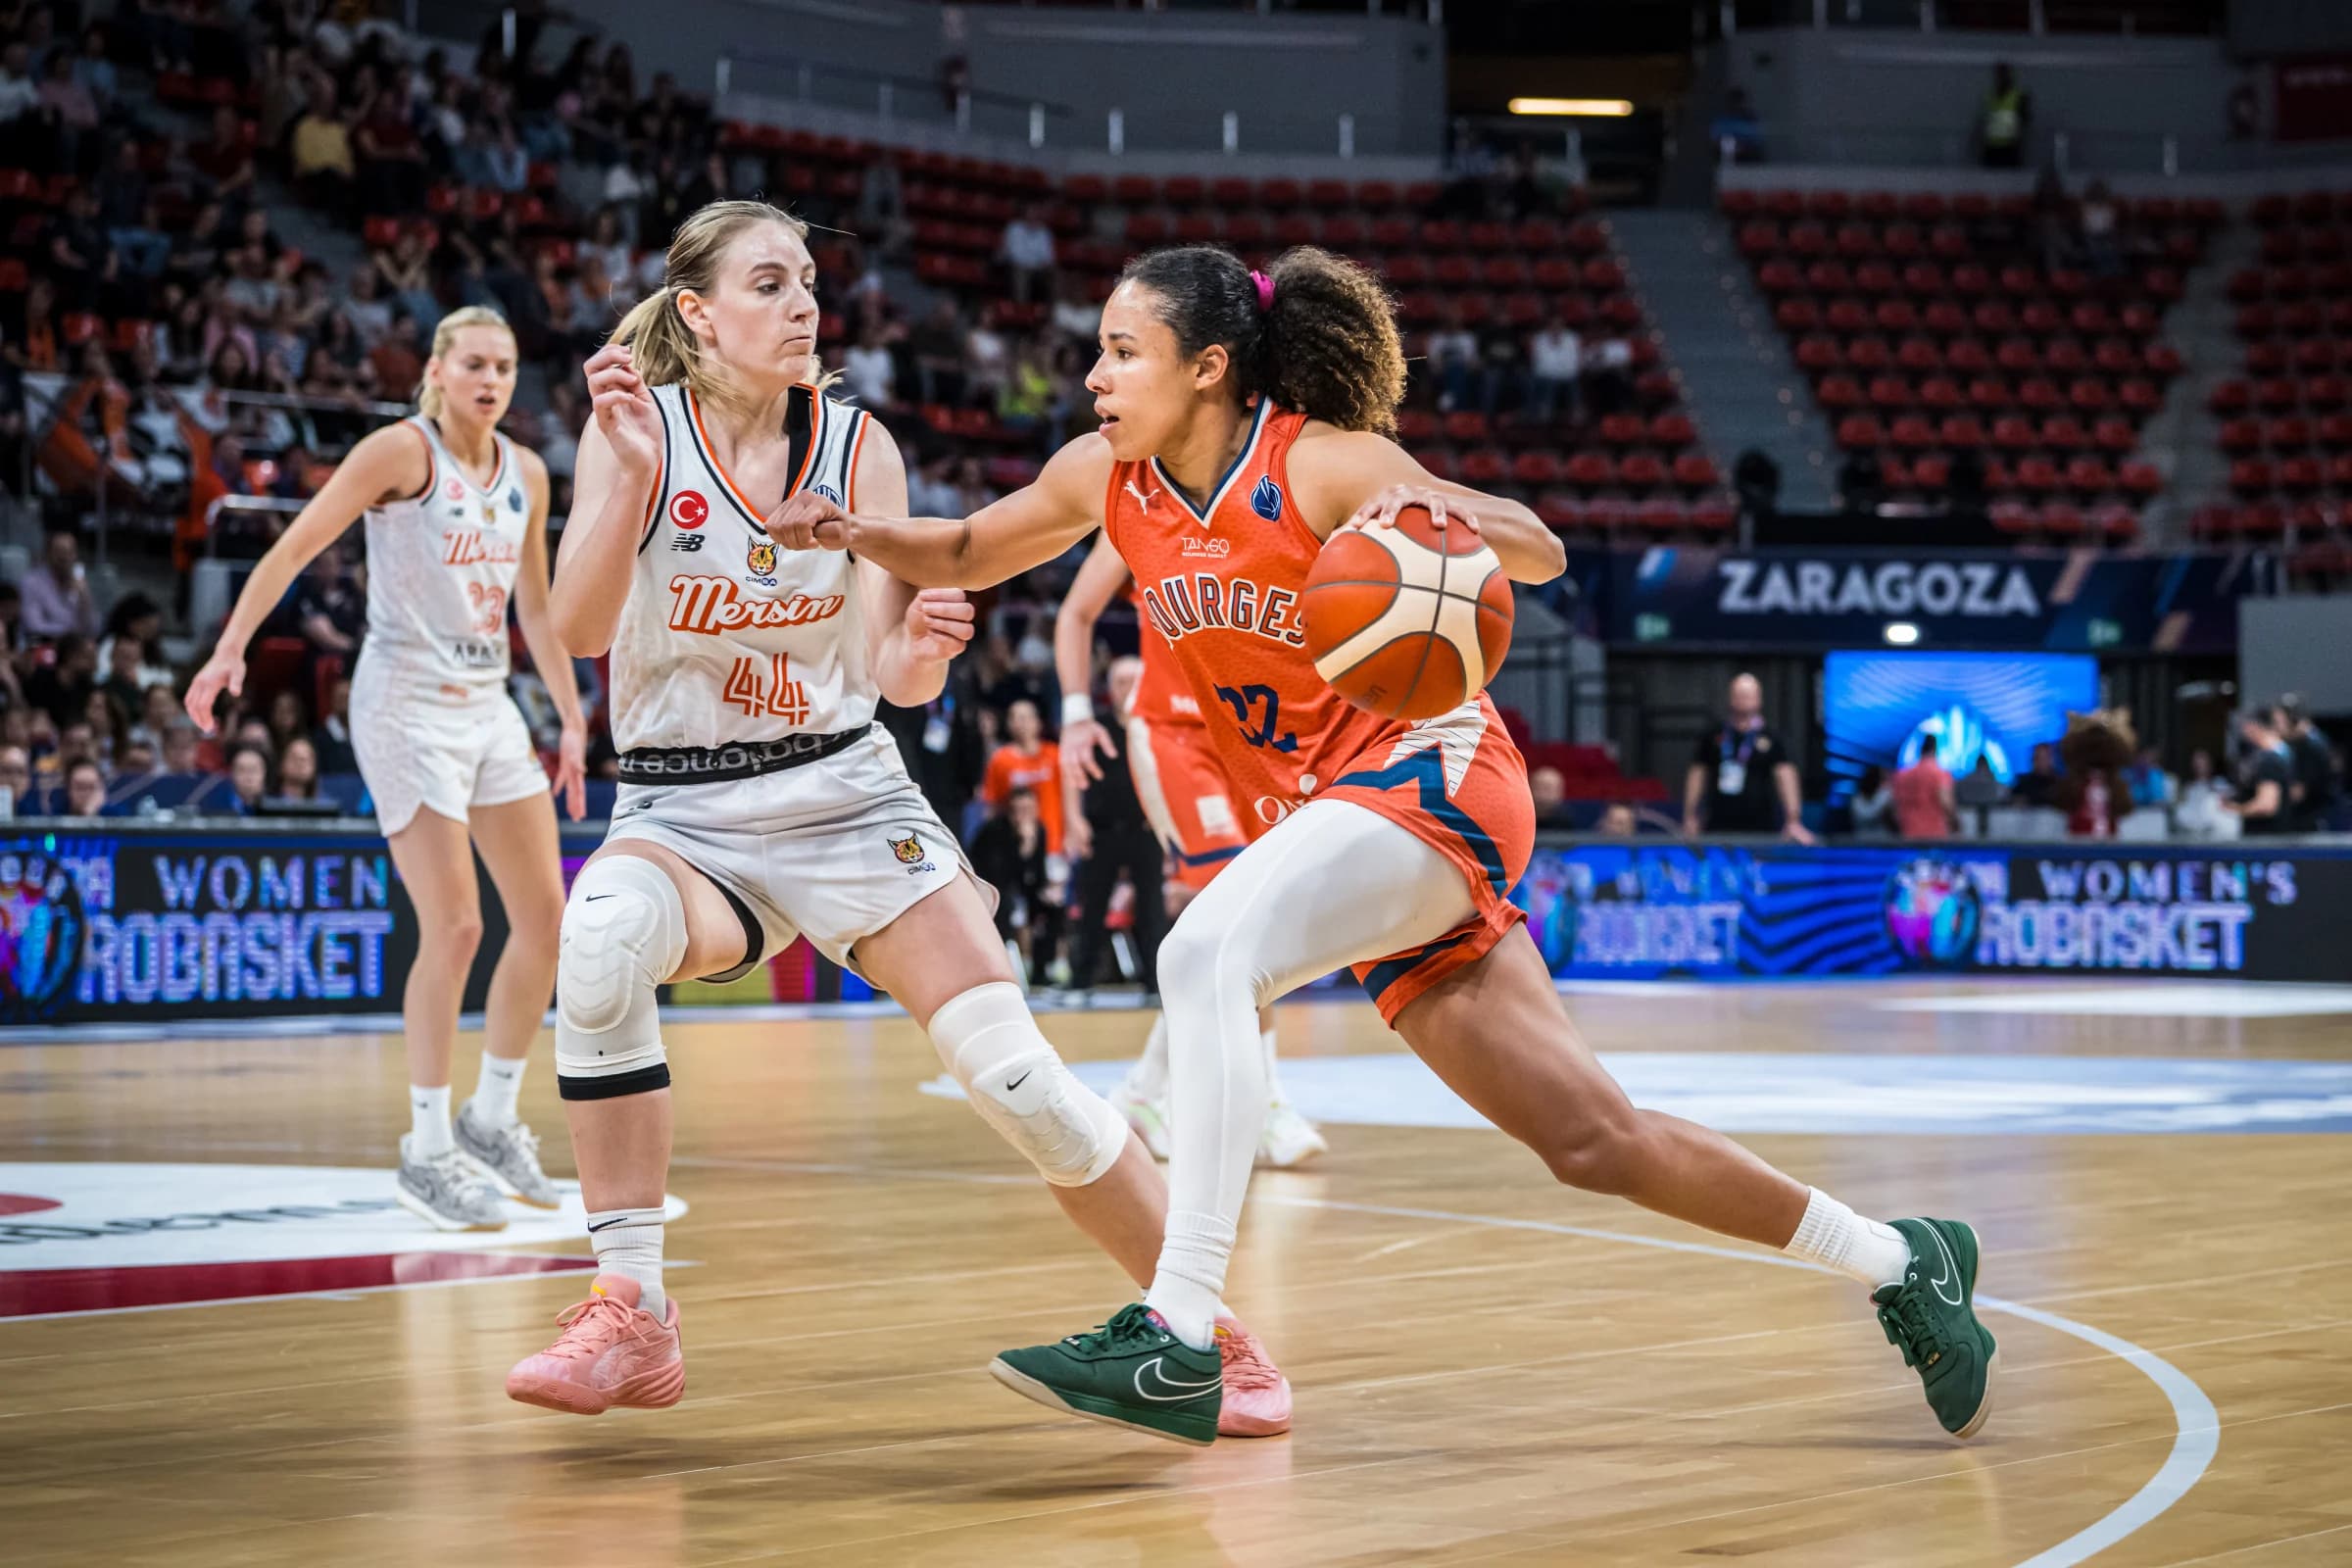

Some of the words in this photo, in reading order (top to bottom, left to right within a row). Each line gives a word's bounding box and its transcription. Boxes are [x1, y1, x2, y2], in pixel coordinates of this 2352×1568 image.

[1181, 537, 1230, 554] TANGO
[668, 574, 845, 636] Mersin
[1719, 560, 2041, 615] ZARAGOZA
[722, 652, 810, 726] 44
[2039, 858, 2298, 906] WOMEN'S
